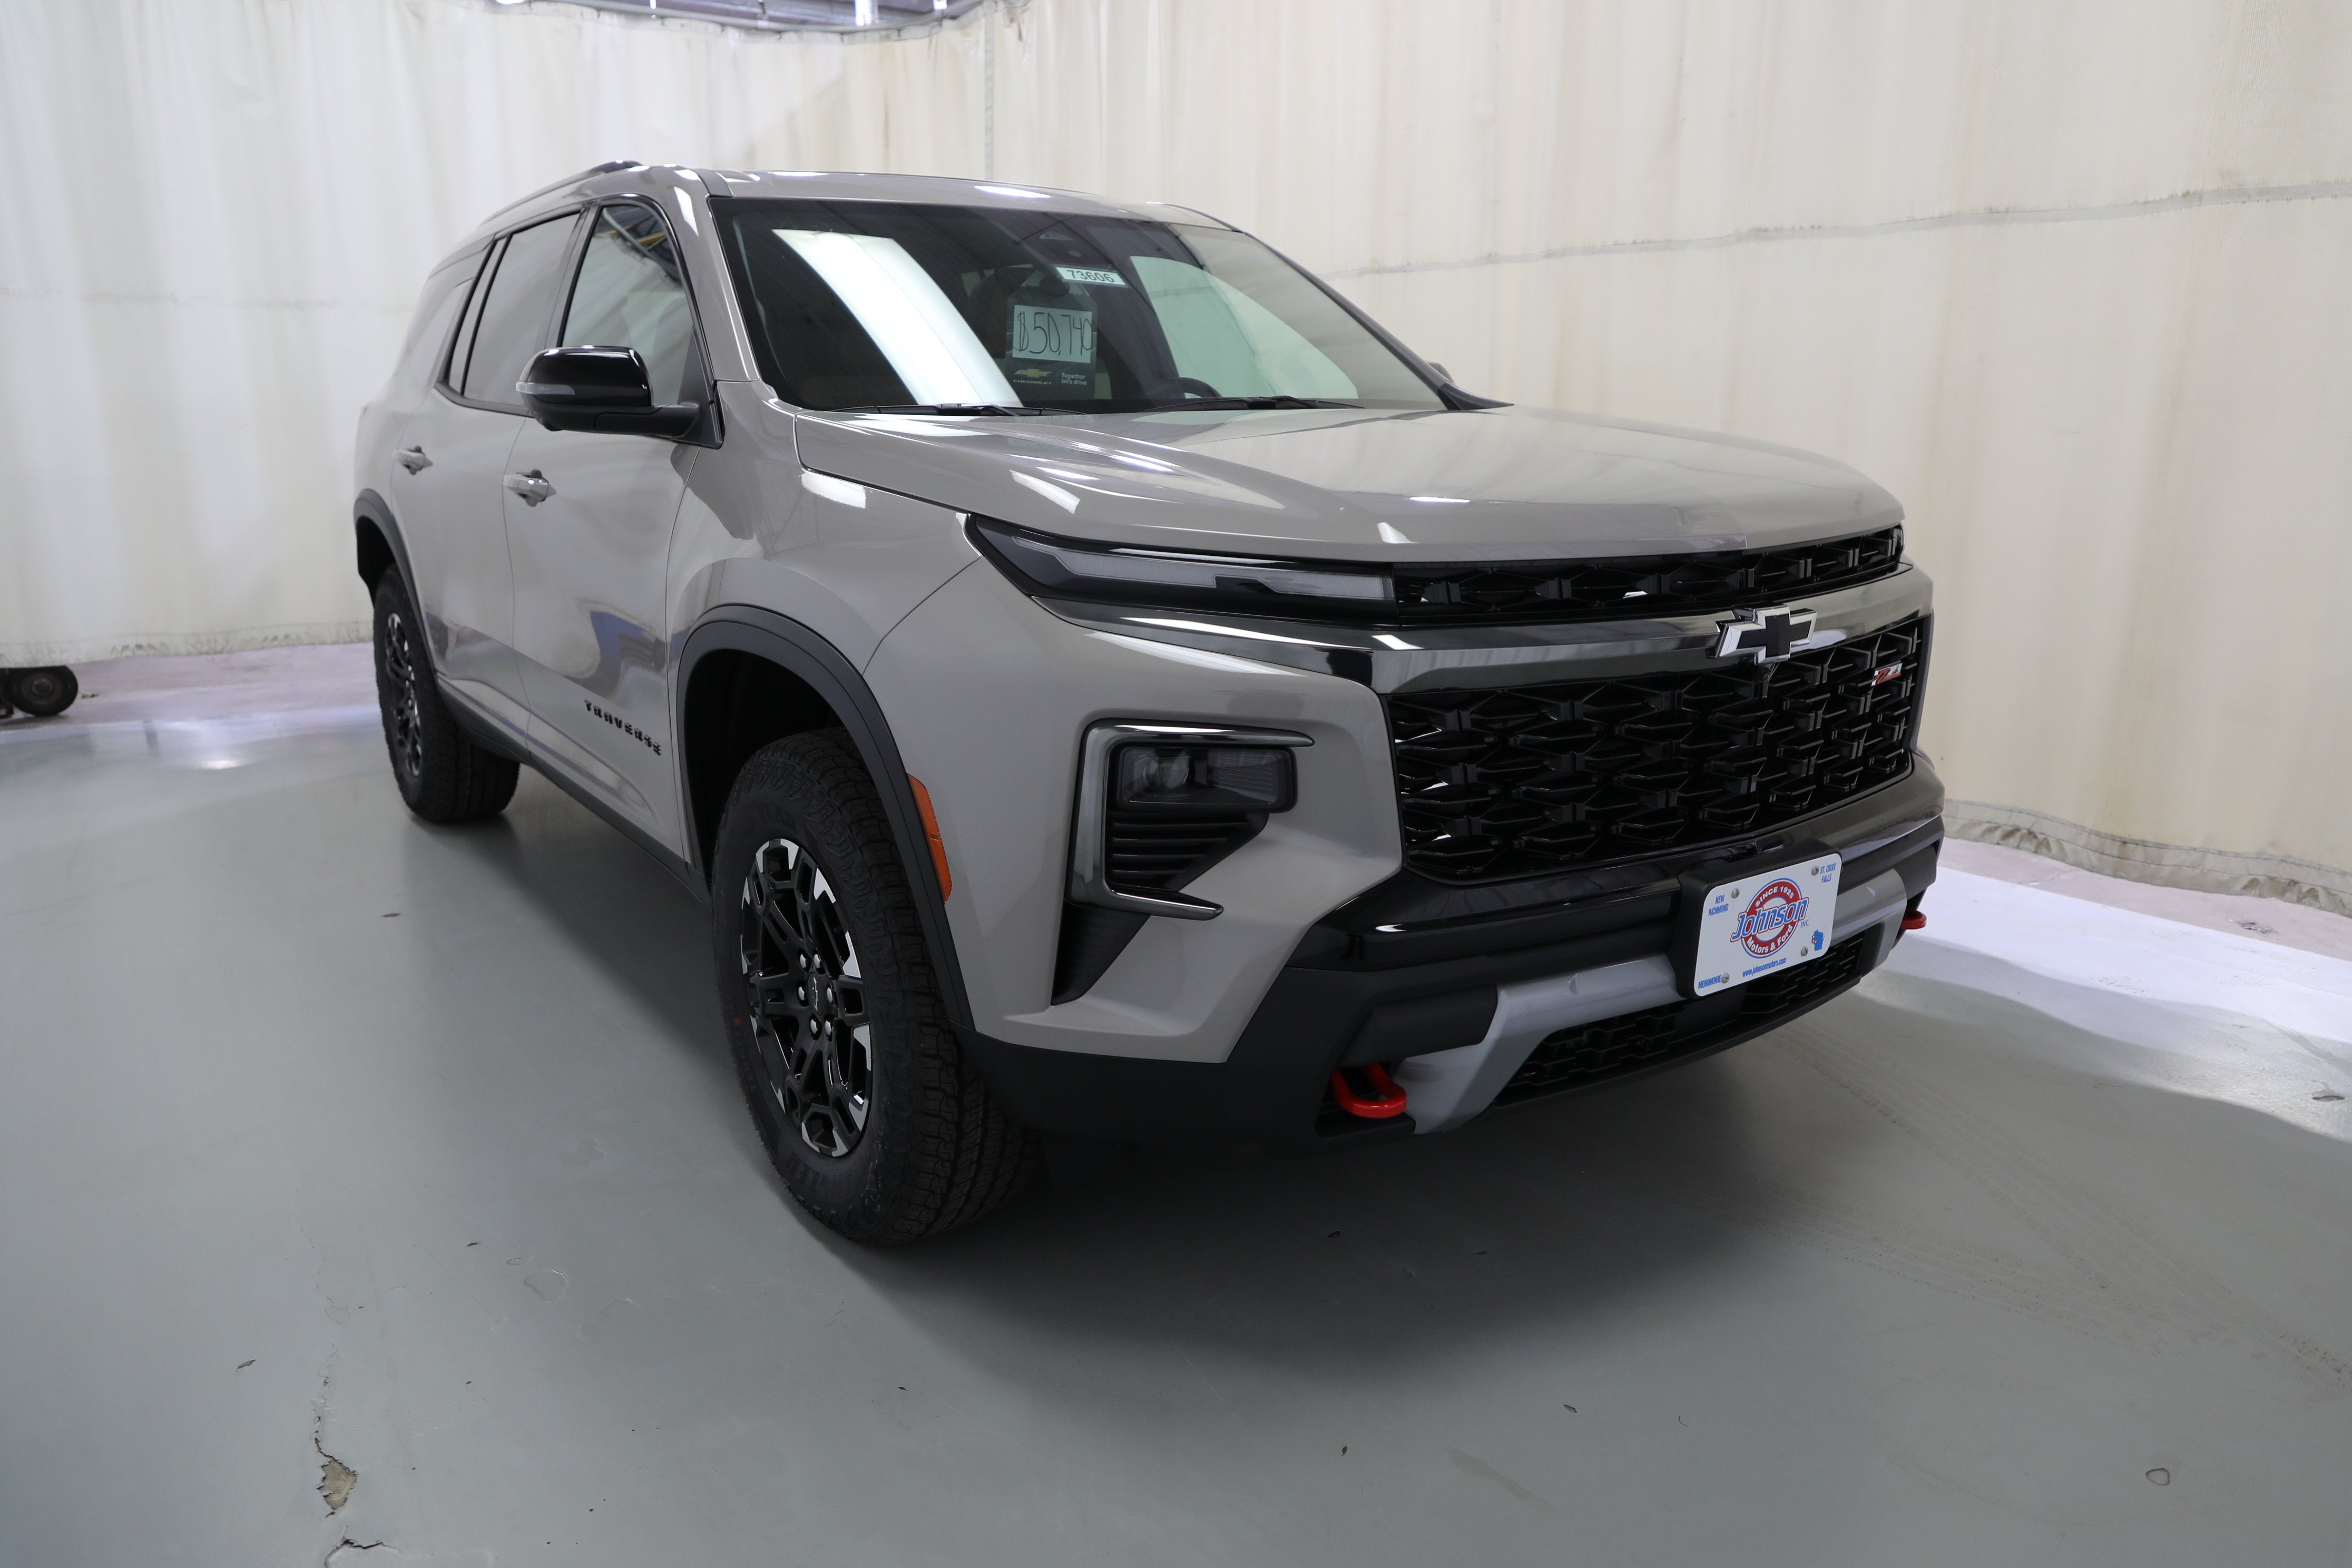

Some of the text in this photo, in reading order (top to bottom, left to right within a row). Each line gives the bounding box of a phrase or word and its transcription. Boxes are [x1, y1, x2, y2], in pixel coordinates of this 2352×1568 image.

[1066, 269, 1115, 282] 73606
[584, 700, 661, 756] TRAVERSE
[1821, 874, 1832, 884] FALLS
[1715, 894, 1725, 904] NEW
[1755, 886, 1795, 907] SINCE 1925
[1708, 903, 1729, 917] RICHMOND
[1730, 897, 1809, 943] Johnson
[1800, 919, 1809, 928] INC.
[1747, 924, 1794, 954] Motors & Ford
[1698, 974, 1722, 989] MENOMONIE
